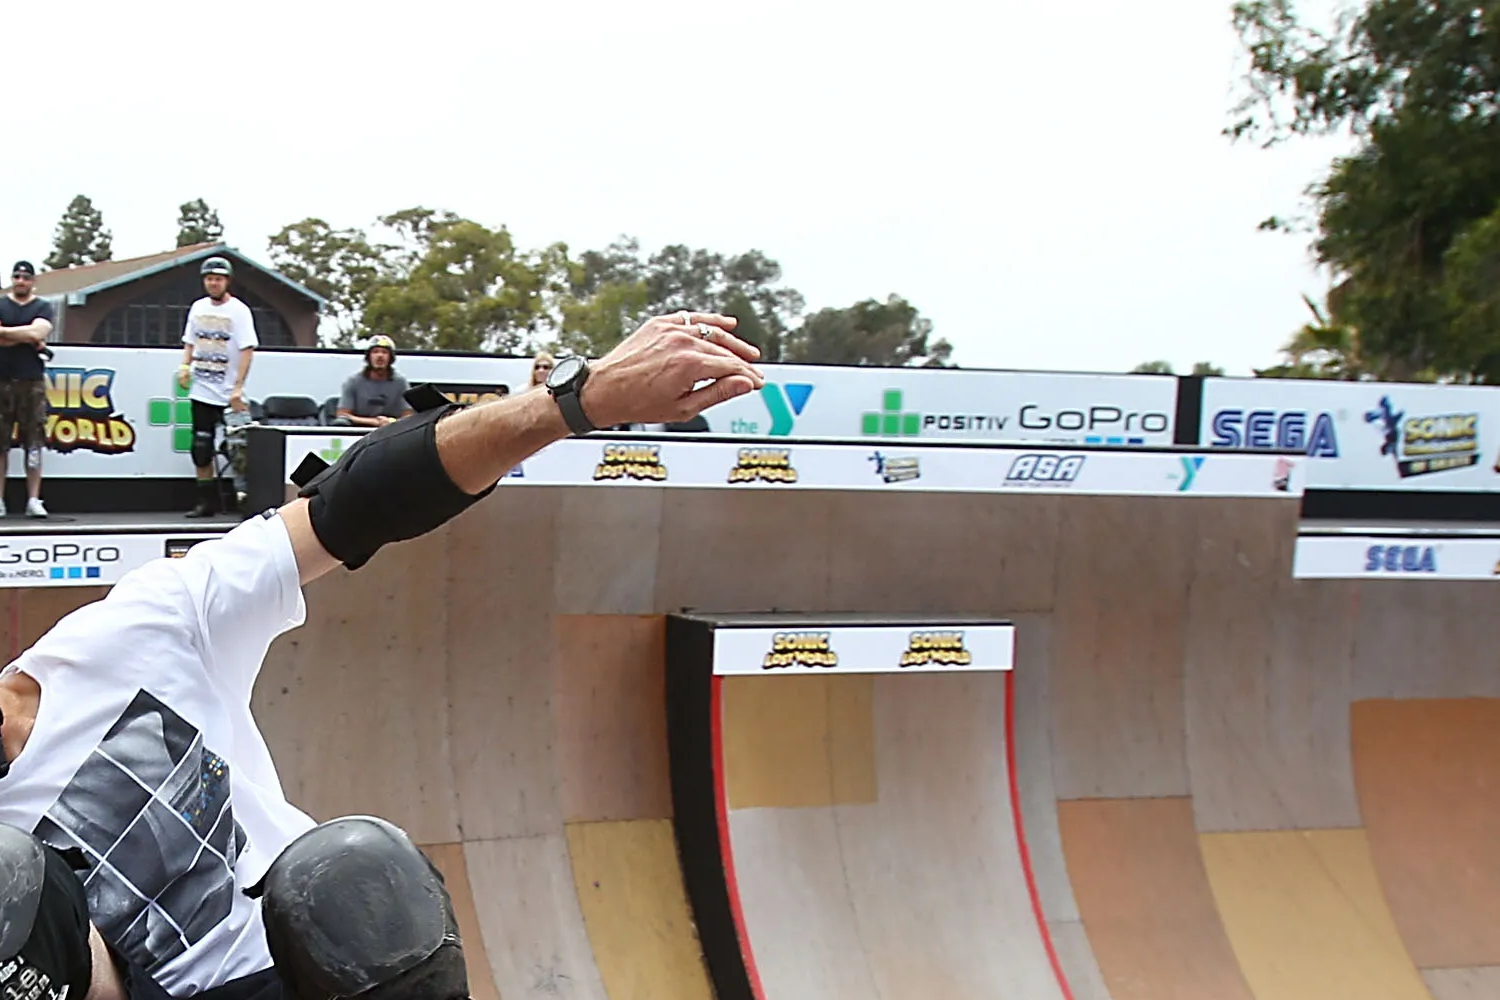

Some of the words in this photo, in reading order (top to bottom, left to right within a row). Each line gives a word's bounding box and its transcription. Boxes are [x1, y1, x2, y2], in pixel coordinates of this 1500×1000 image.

[731, 419, 758, 434] the
[924, 414, 1010, 432] POSITIV
[1019, 404, 1168, 432] GoPro
[1211, 410, 1338, 458] SEGA
[603, 444, 660, 463] SONIC
[738, 448, 791, 467] SONIC
[1006, 454, 1086, 481] ASA
[1365, 545, 1436, 572] SEGA
[773, 632, 830, 651] SONIC
[909, 631, 964, 650] SONIC
